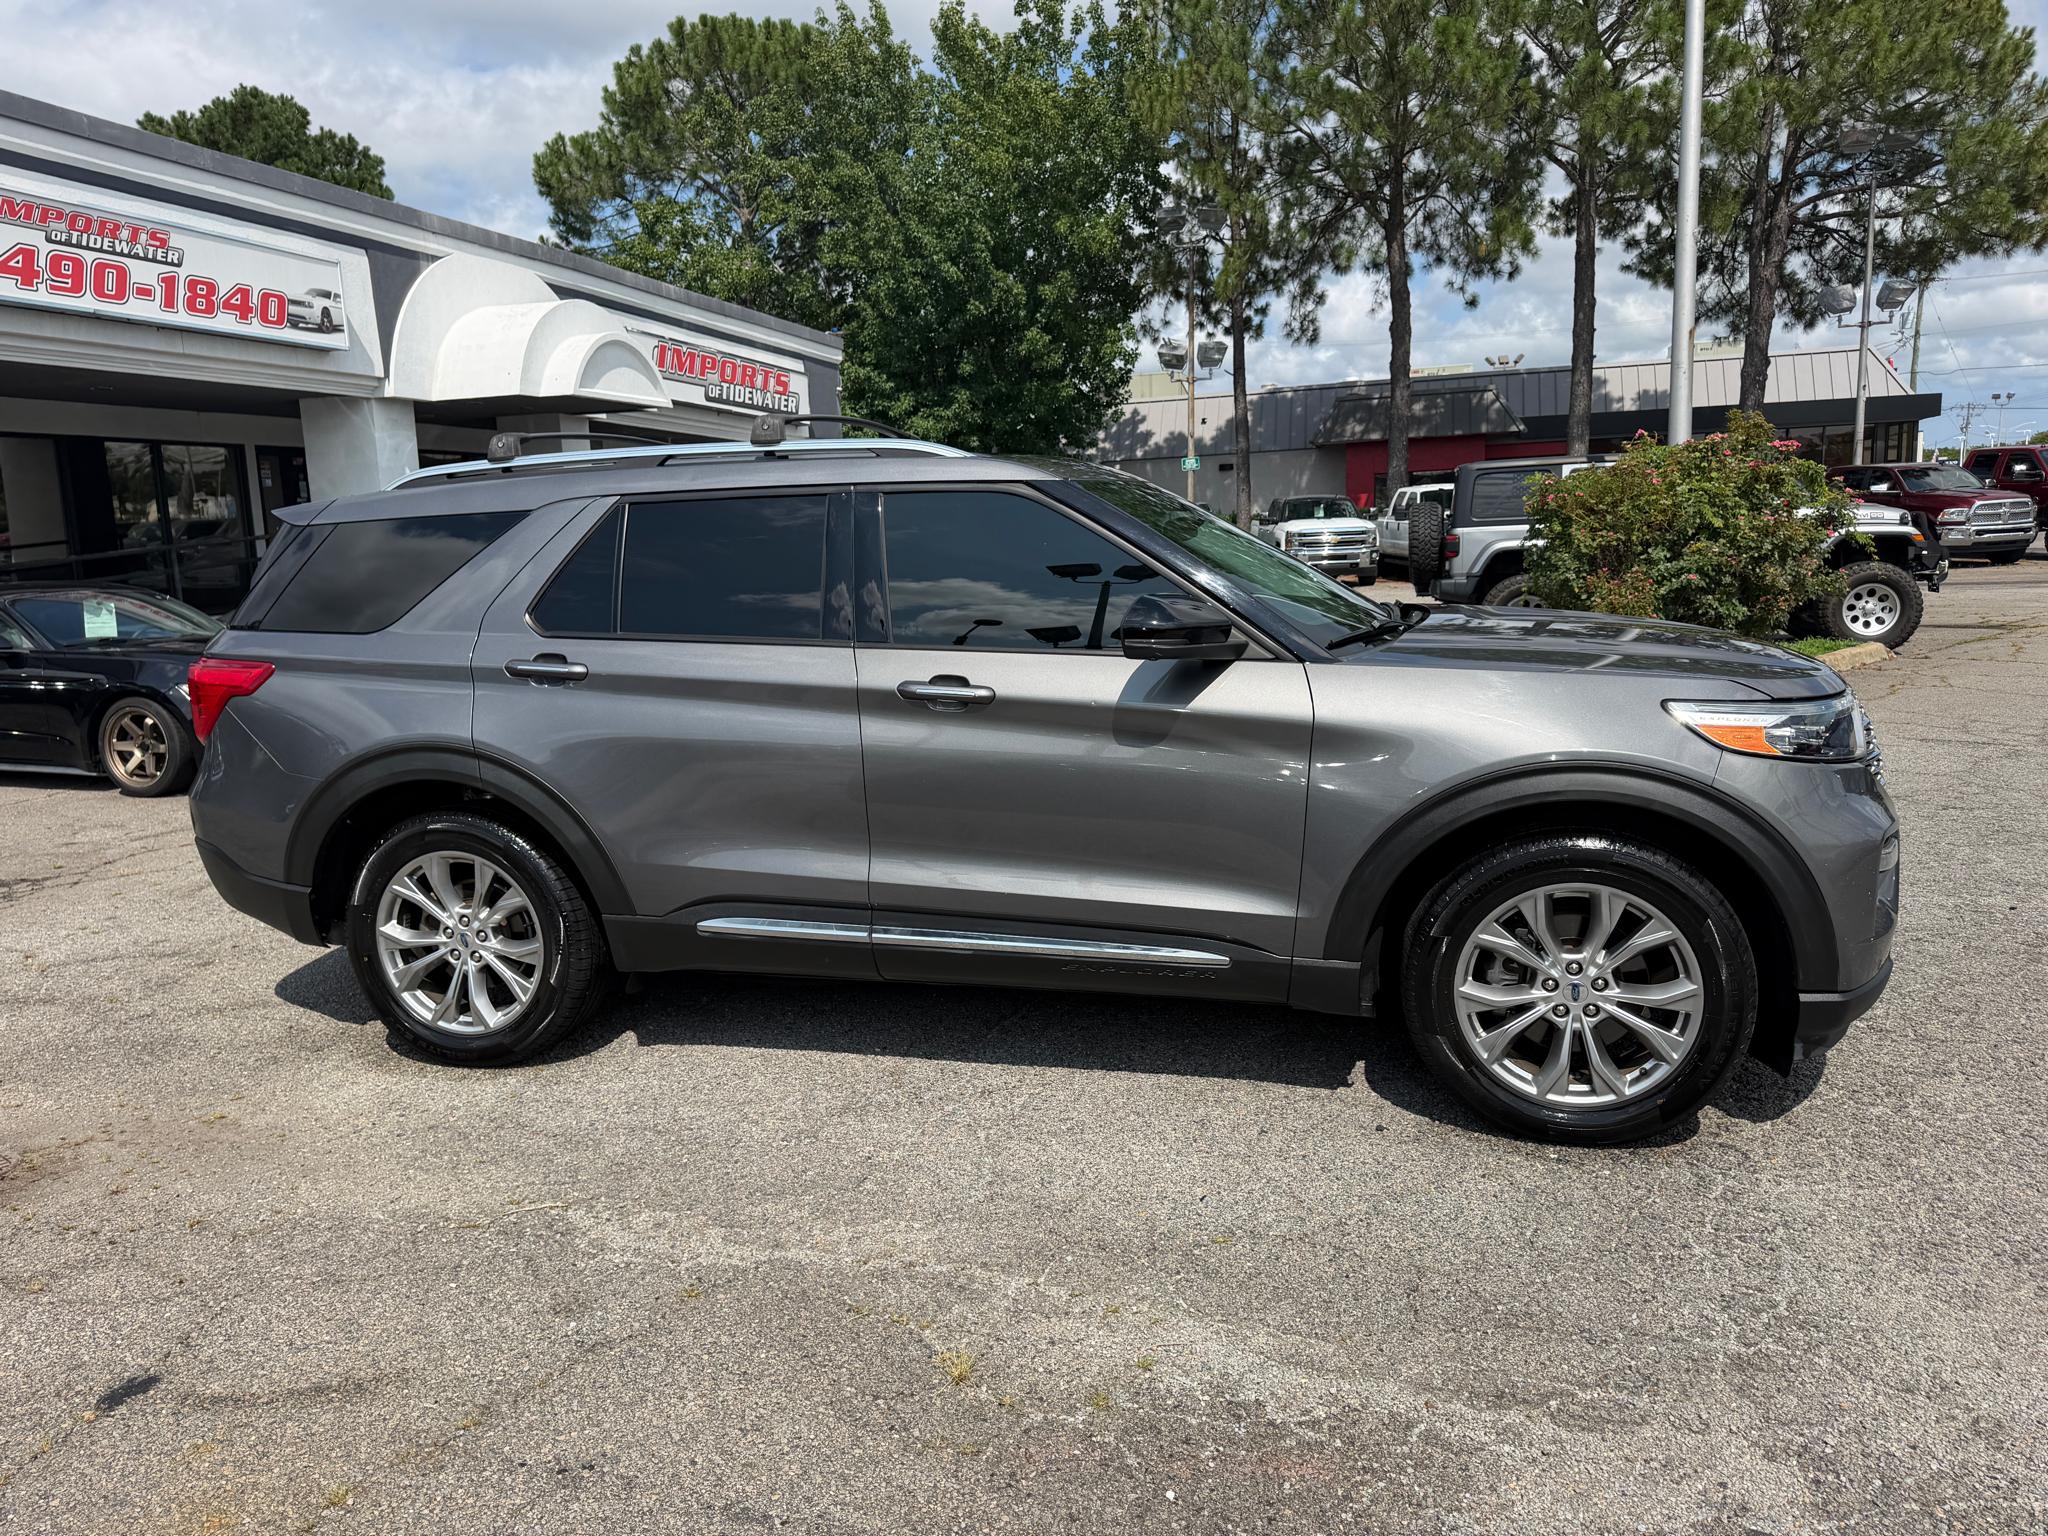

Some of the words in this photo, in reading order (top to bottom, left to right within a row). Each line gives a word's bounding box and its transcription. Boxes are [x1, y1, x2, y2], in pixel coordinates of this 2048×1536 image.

[0, 195, 171, 250] MPORTS
[51, 230, 70, 242] OF
[69, 230, 180, 265] TIDEWATER
[0, 242, 289, 330] 490-1840
[656, 340, 791, 396] IMPORTS
[708, 383, 722, 398] OF
[719, 382, 797, 413] TIDEWATER
